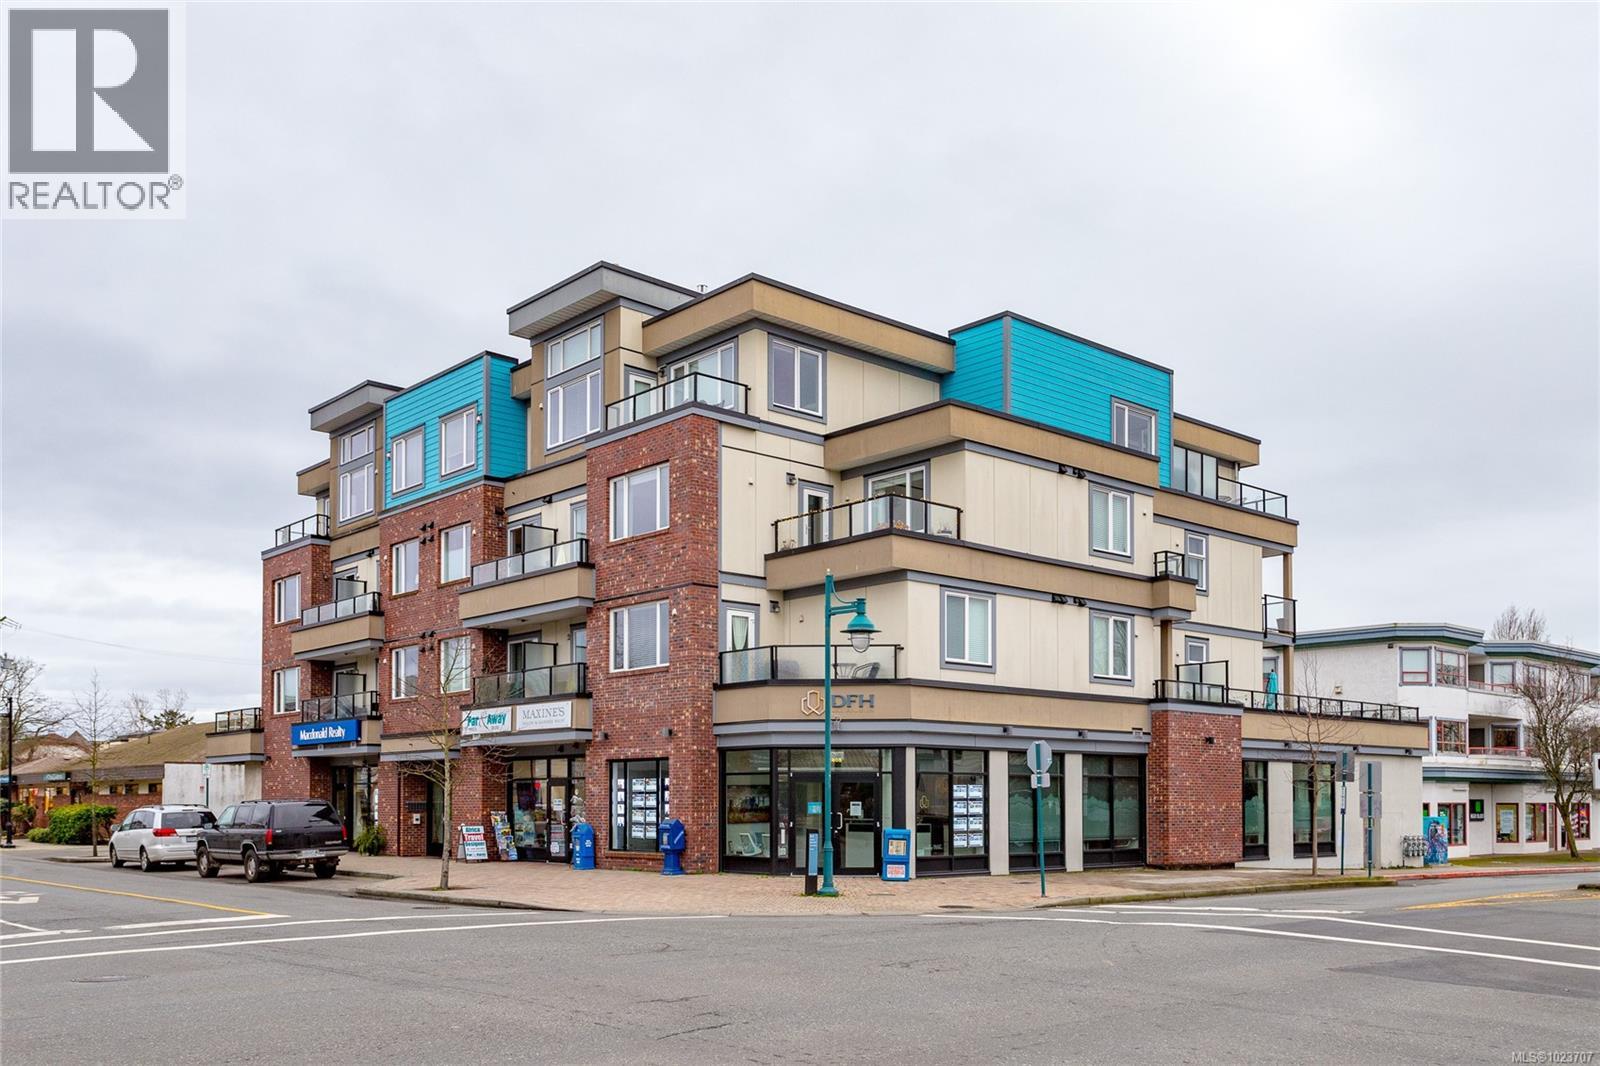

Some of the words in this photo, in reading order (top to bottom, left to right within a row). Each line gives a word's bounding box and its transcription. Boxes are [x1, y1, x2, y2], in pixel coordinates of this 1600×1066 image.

[831, 694, 875, 708] DFH
[486, 713, 507, 725] Away
[300, 727, 328, 740] Macdonald
[328, 726, 345, 739] Realty
